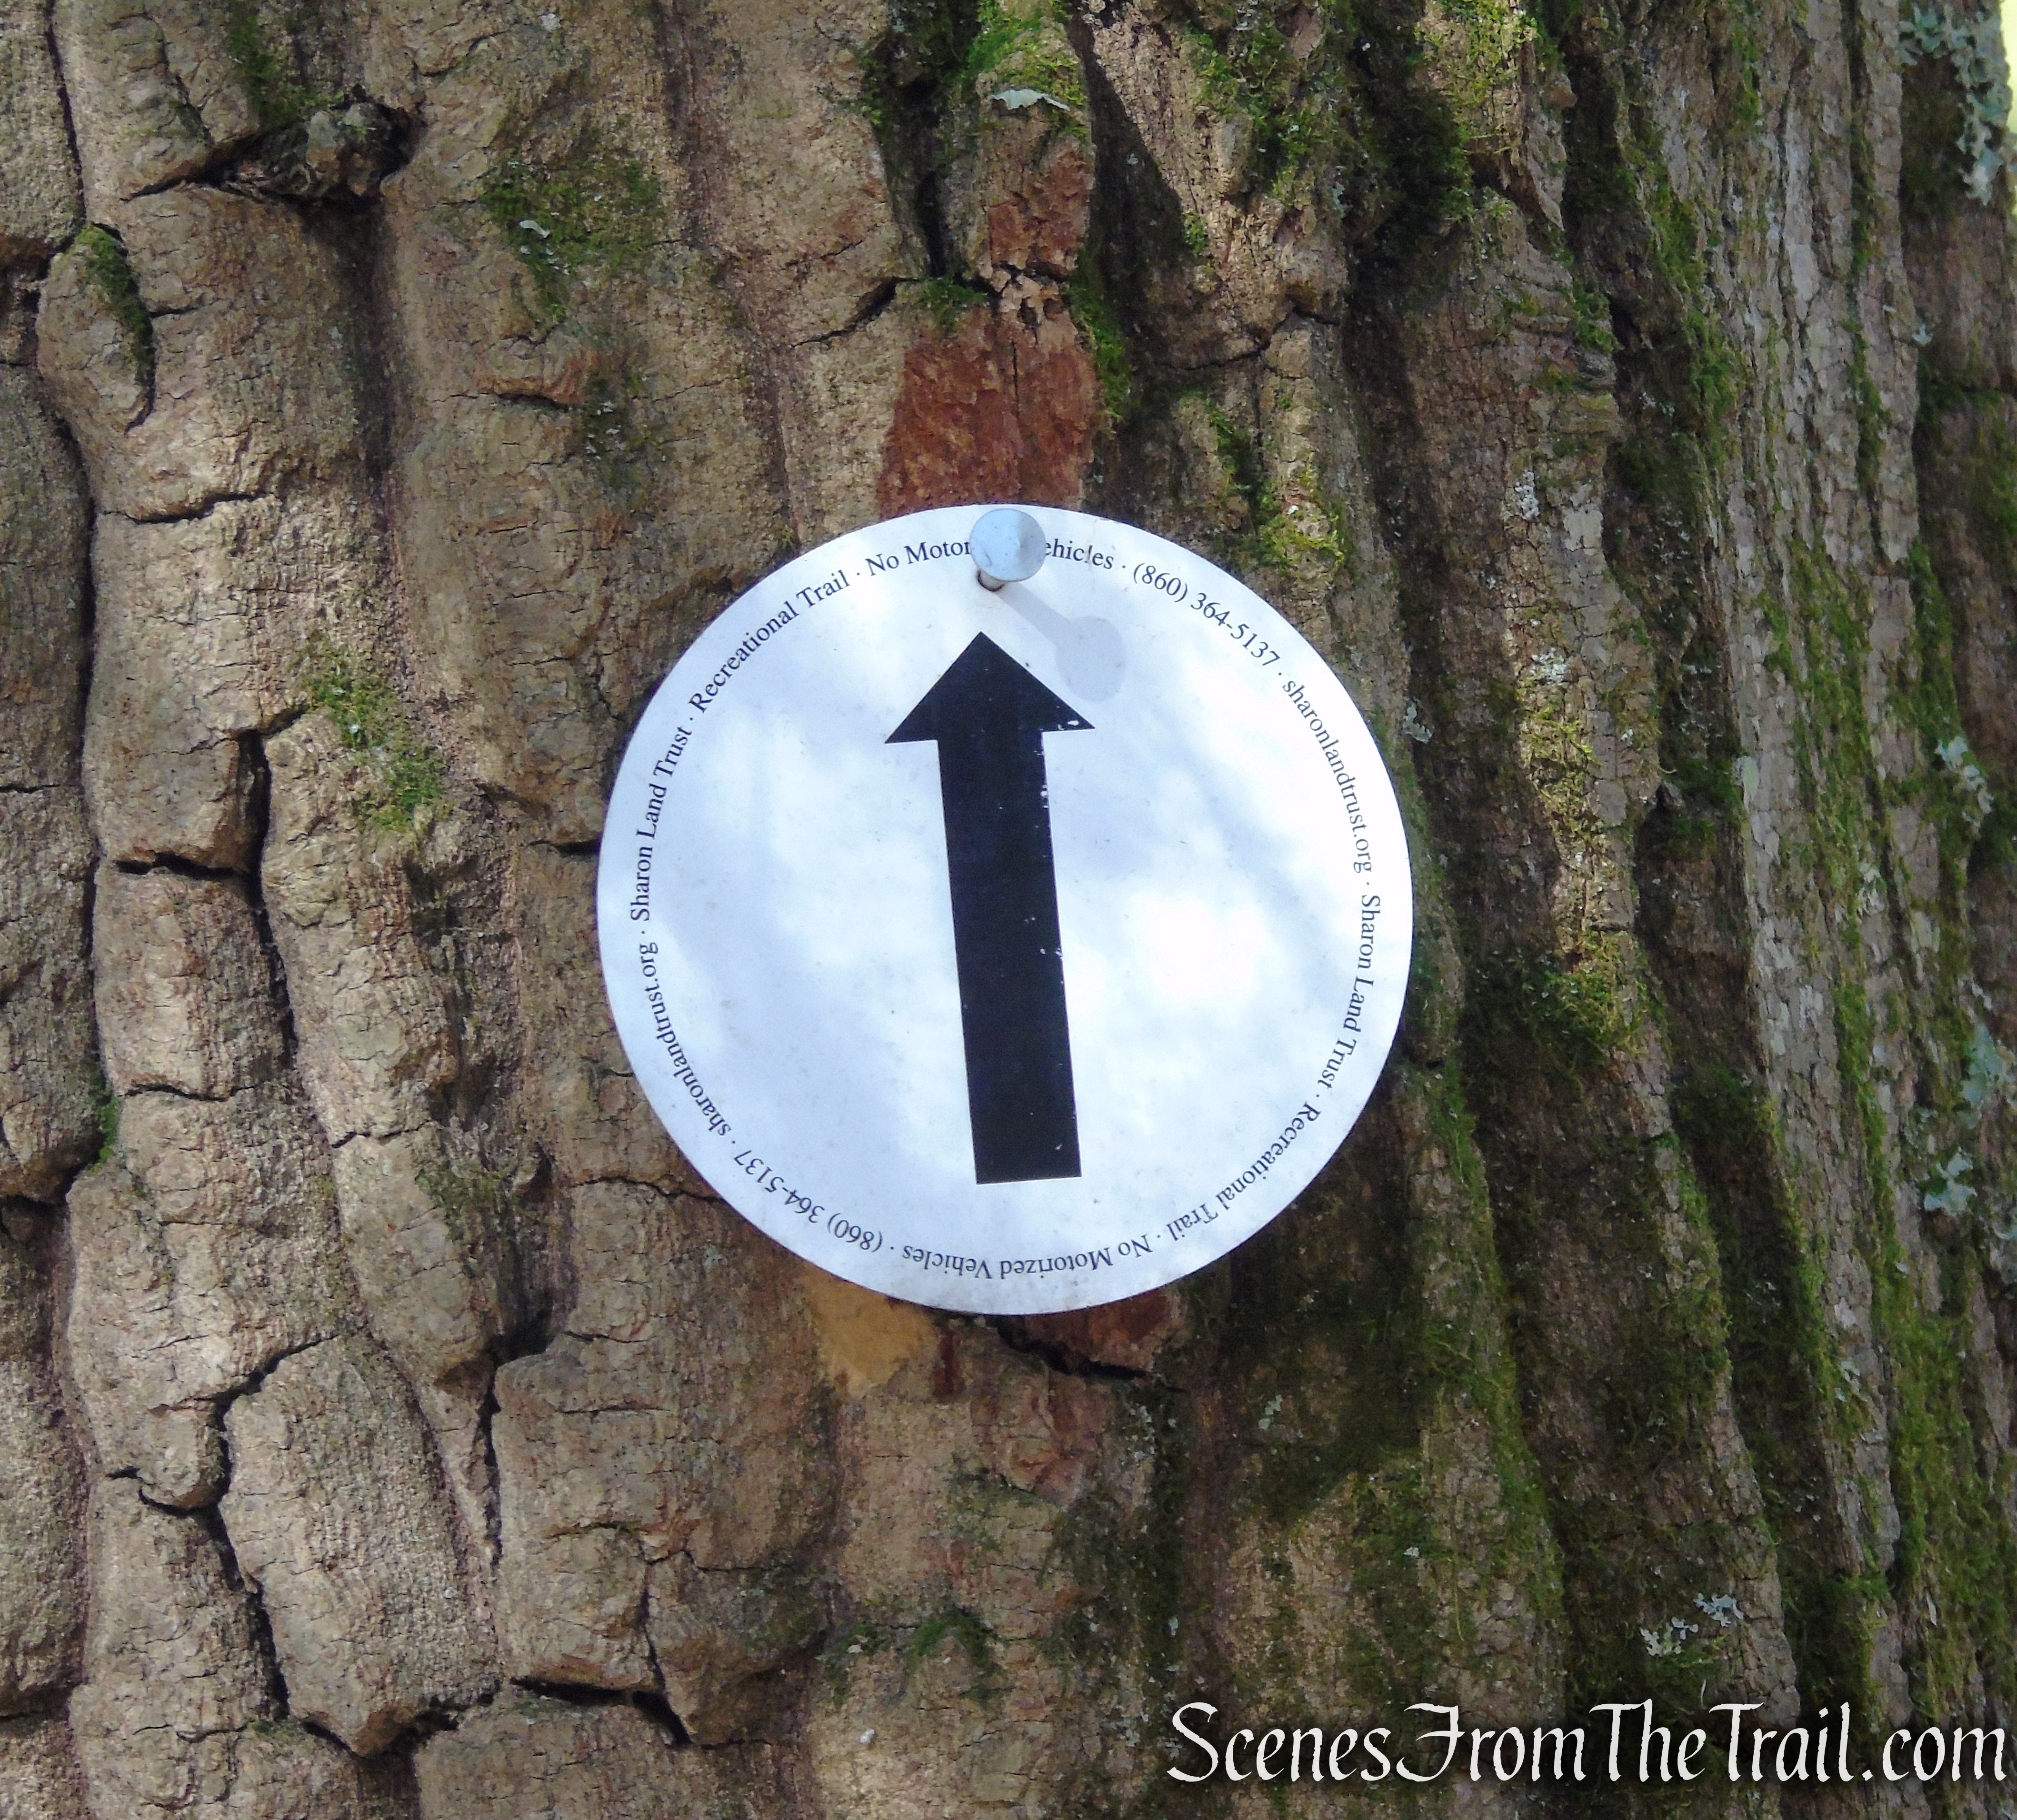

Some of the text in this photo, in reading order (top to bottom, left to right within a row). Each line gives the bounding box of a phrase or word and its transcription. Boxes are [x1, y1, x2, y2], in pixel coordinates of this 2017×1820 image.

[630, 538, 1372, 922] Sharon Land Trust Recreational Trail No Motor ehicles (860) 364-5137 sharonlandtrust.org
[639, 895, 1381, 1280] Sharon Land Trust Recreational Trail No Motorized Vehicles (860) 364-5137 sharonlandtrust.org
